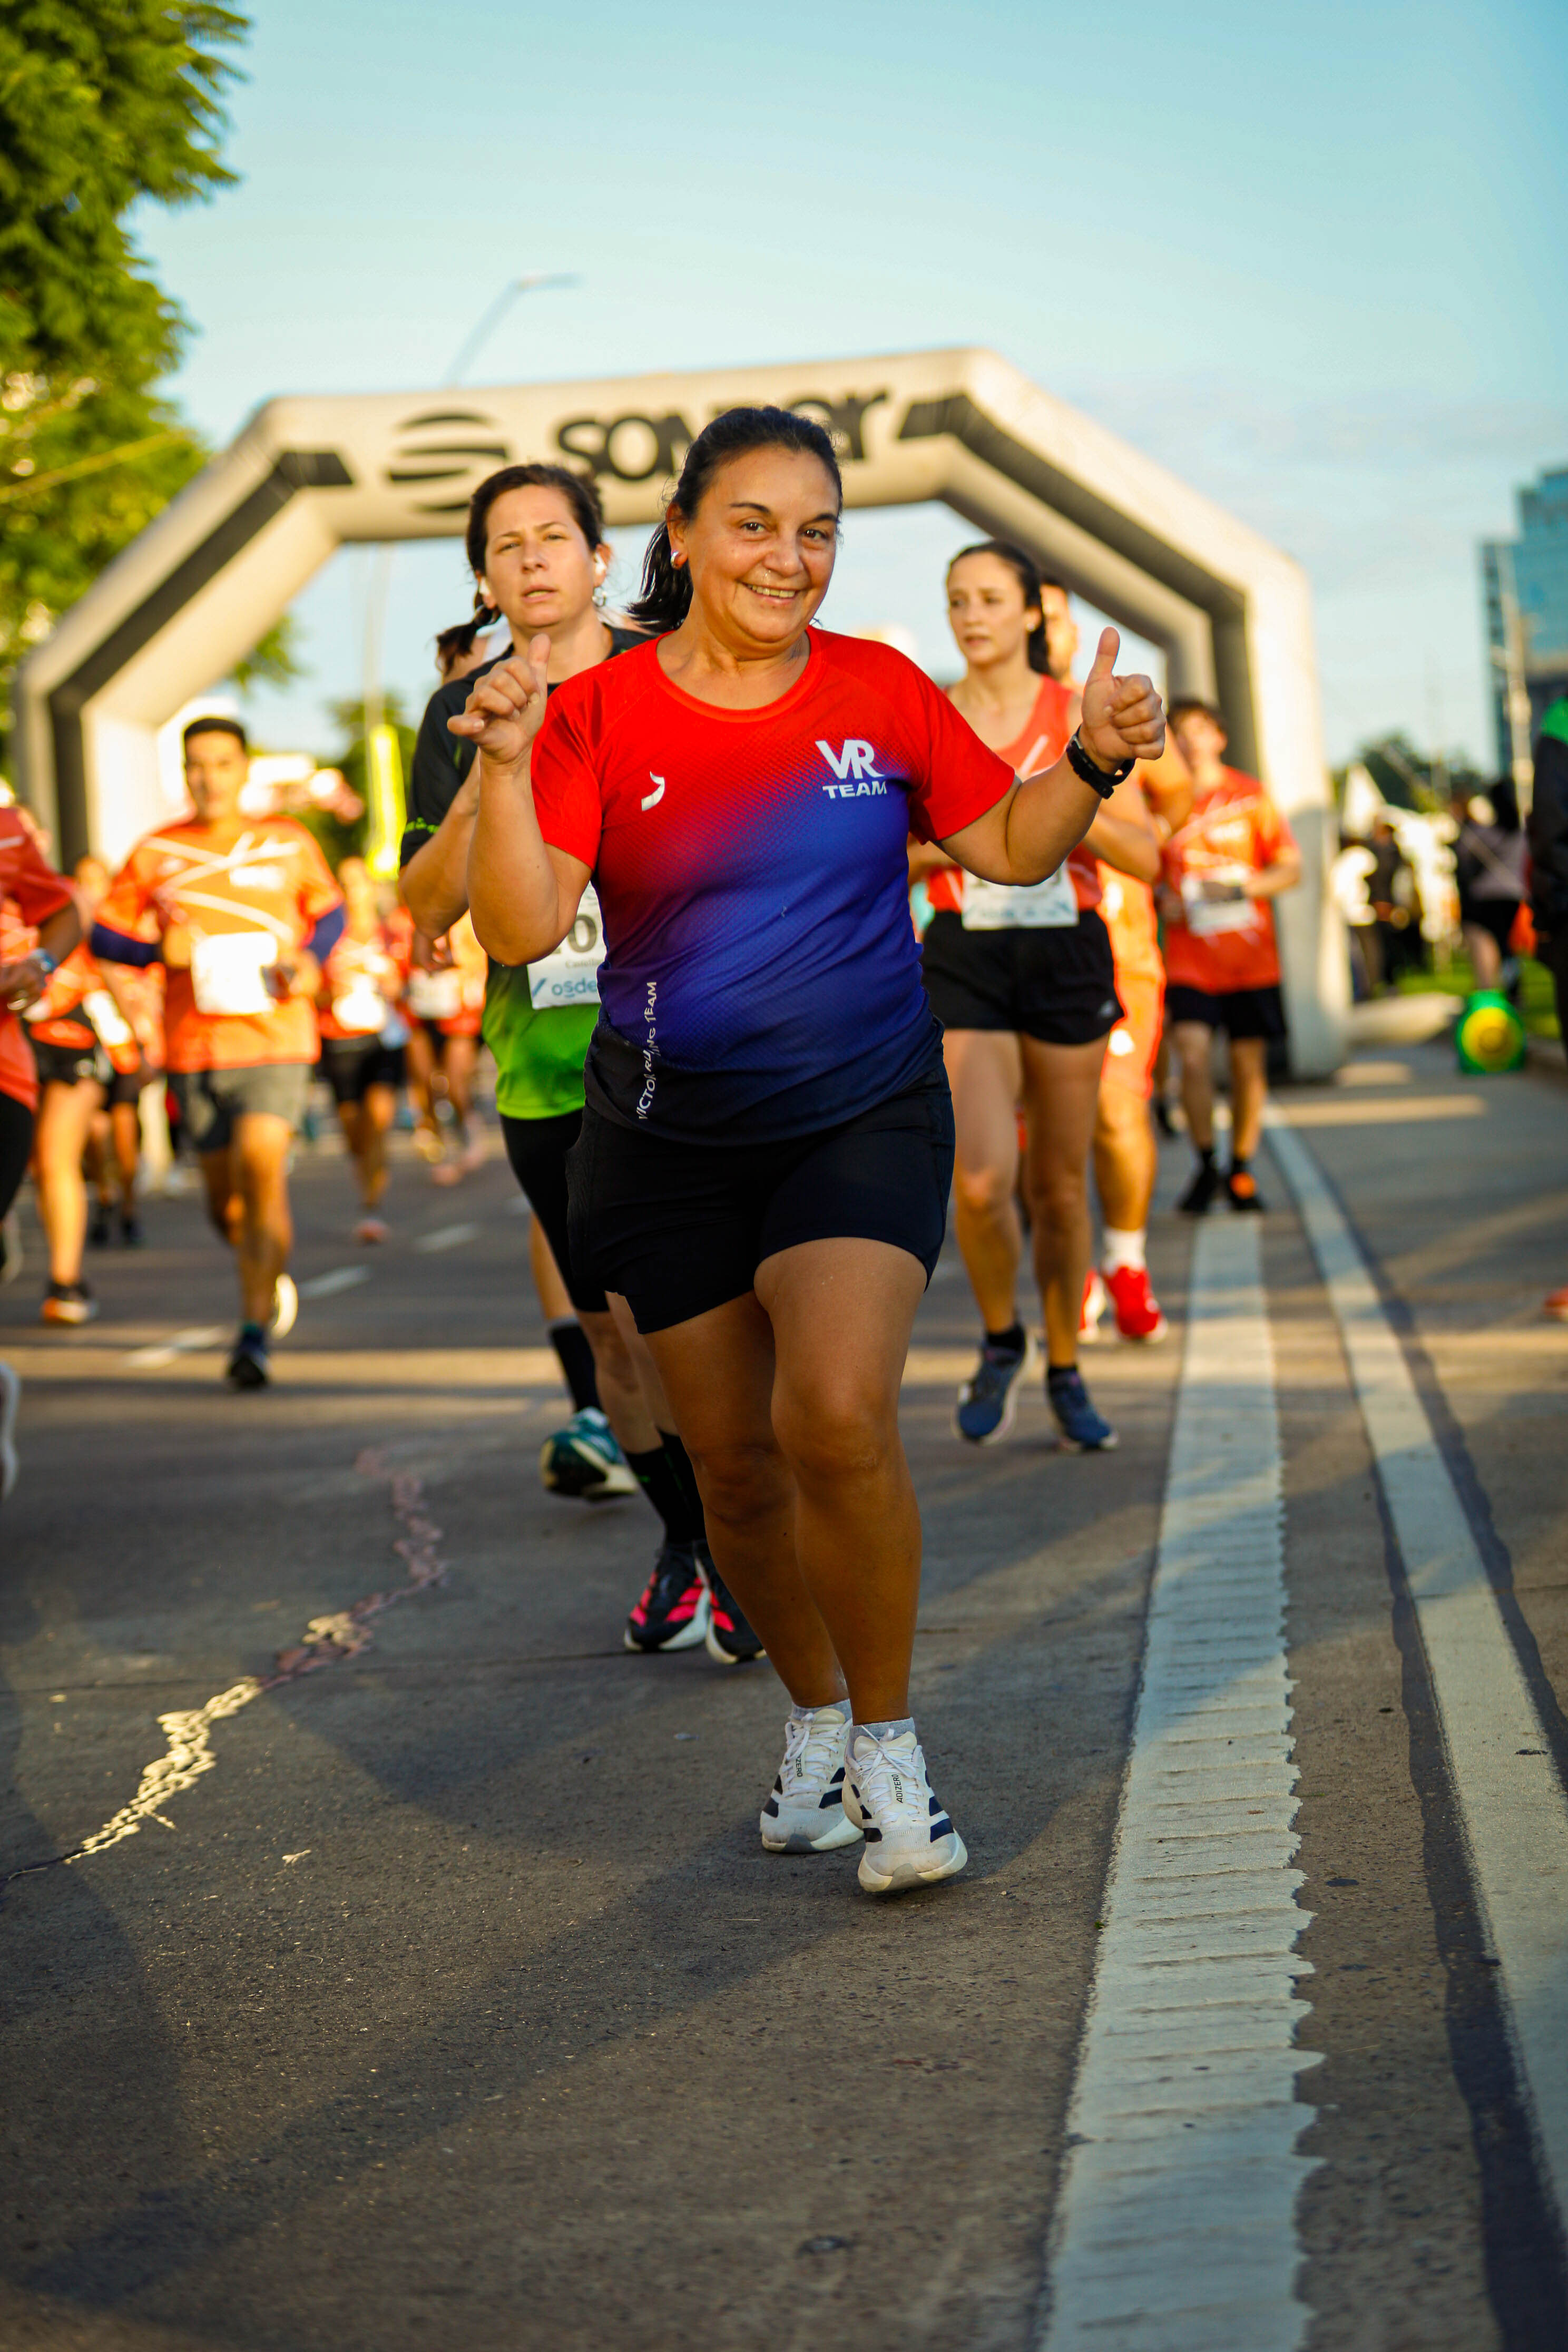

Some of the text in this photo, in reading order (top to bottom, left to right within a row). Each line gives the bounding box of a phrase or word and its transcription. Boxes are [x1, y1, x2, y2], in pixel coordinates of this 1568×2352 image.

[815, 739, 885, 779] VR
[822, 781, 887, 799] TEAM
[644, 982, 657, 1023] TEAM
[636, 1073, 656, 1120] VICTOR
[891, 1774, 903, 1804] ADIZERO
